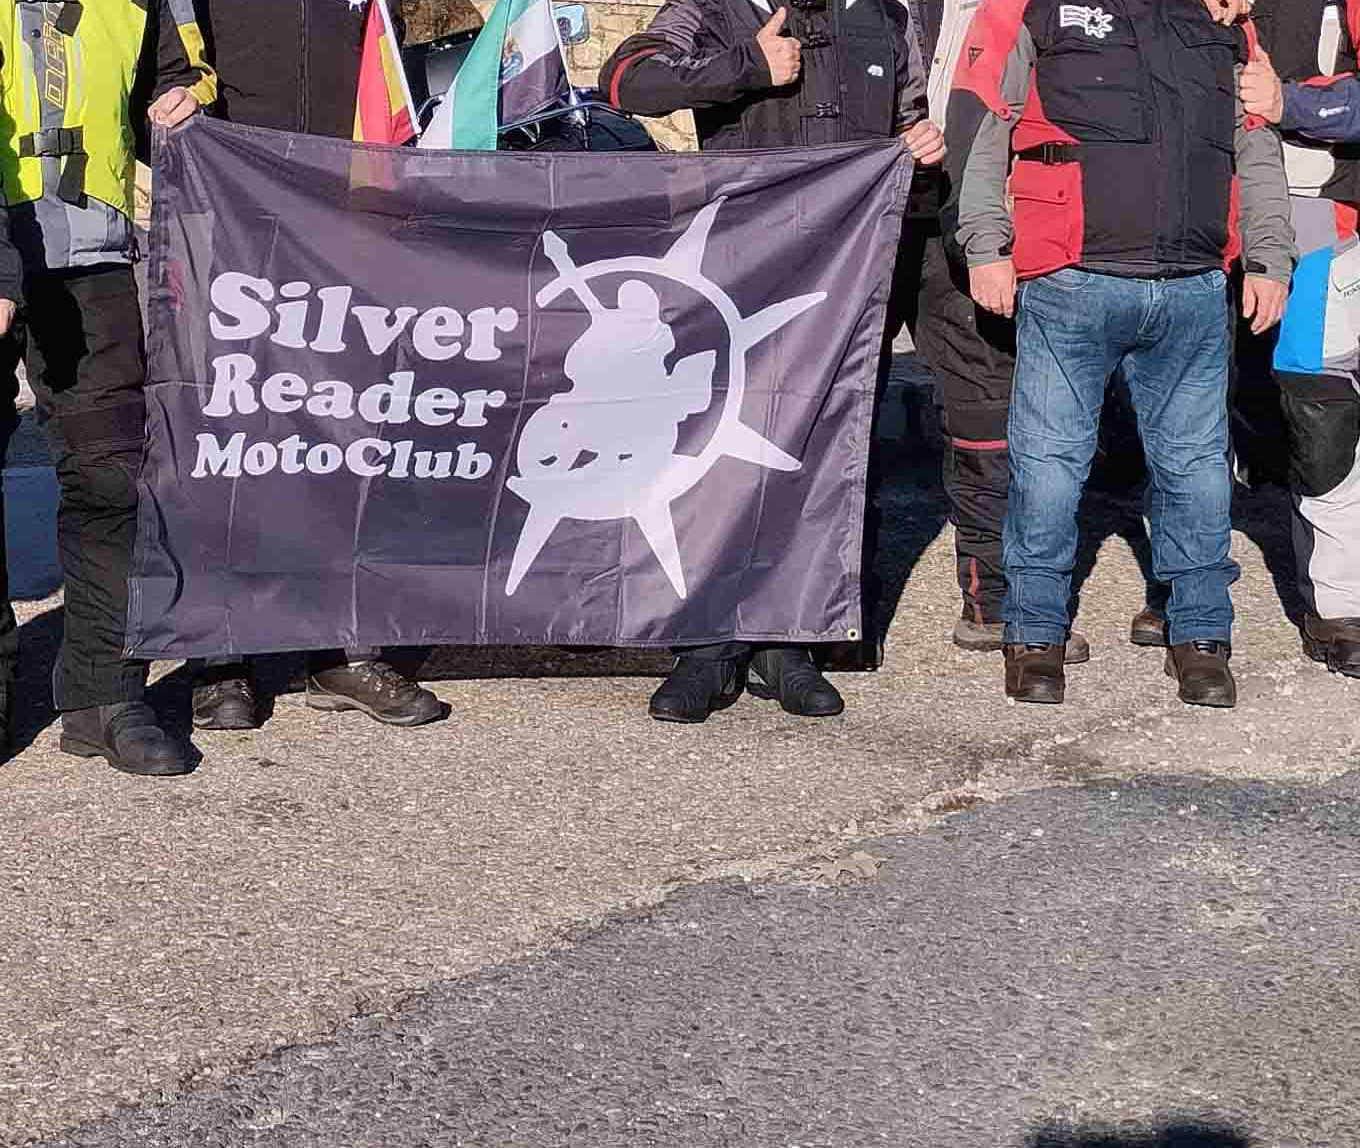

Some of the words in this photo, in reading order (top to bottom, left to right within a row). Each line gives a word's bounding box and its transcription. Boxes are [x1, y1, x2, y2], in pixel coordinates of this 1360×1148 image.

[209, 271, 519, 361] Silver
[202, 352, 507, 427] Reader
[191, 432, 493, 479] MotoClub
